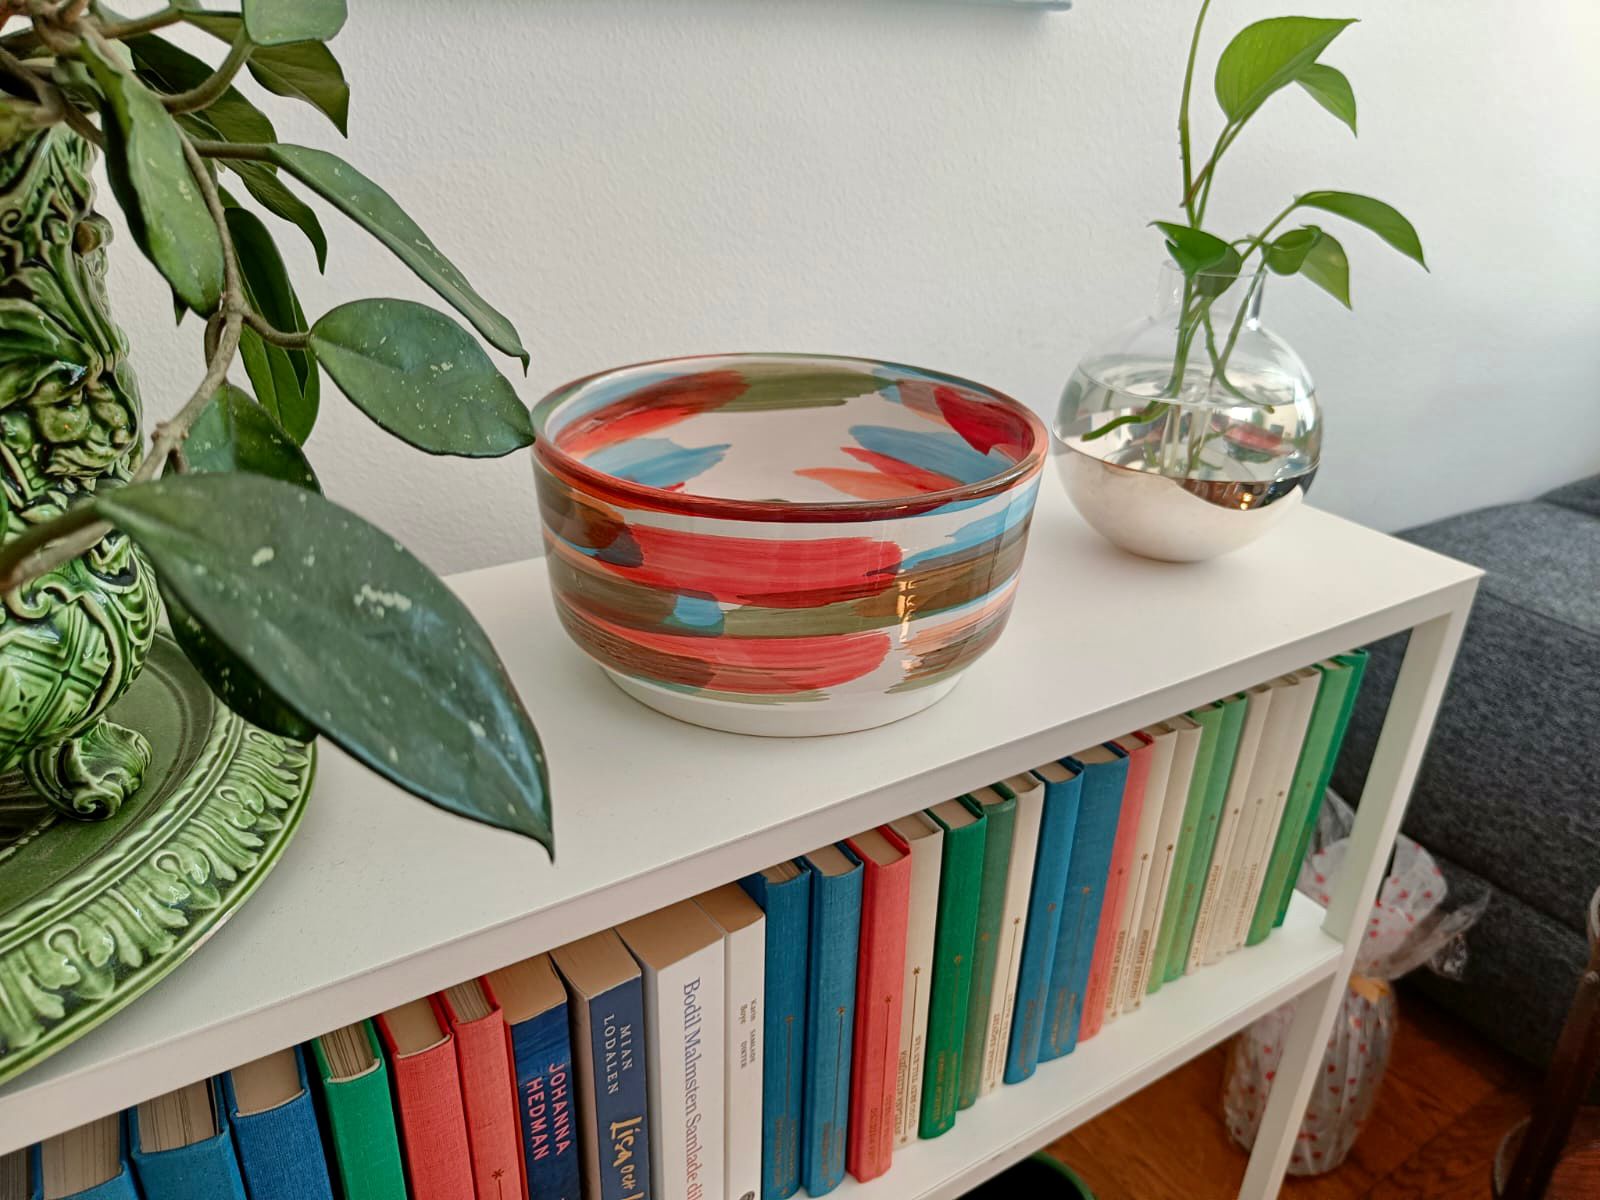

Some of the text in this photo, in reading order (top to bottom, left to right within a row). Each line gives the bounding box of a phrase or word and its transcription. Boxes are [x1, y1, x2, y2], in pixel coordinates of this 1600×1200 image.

[684, 976, 702, 1030] Bodil
[603, 1013, 620, 1095] LODALEN
[620, 1024, 633, 1070] MIAN
[684, 1028, 703, 1117] Malmsten
[526, 1076, 550, 1161] HEDMAN
[549, 1063, 572, 1155] JOHANNA
[609, 1116, 643, 1168] Lisa
[685, 1113, 704, 1181] Samlade
